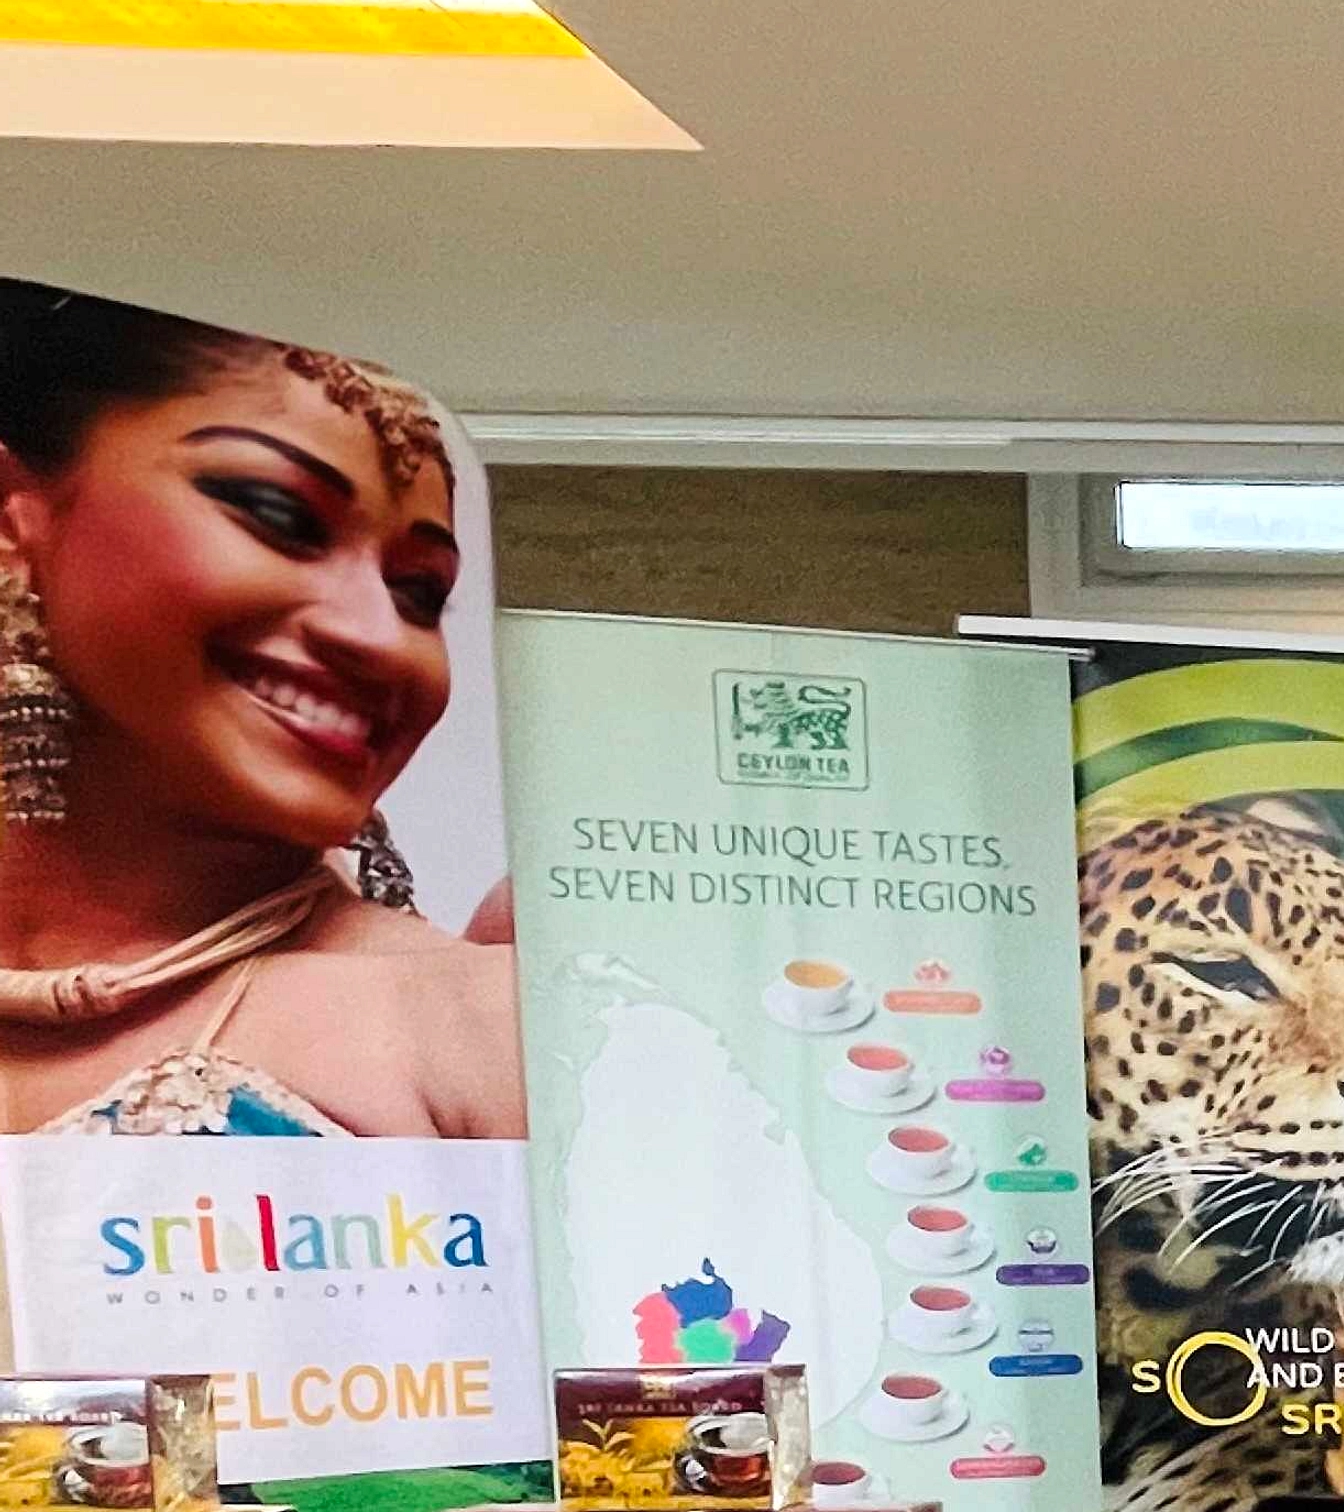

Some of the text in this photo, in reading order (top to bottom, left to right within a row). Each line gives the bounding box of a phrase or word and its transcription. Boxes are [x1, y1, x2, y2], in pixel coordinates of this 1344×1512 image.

[737, 752, 850, 773] CEYLON TEA
[573, 816, 698, 855] SEVEN
[712, 823, 860, 867] UNIQUE
[548, 866, 1036, 917] SEVEN DISTINCT REGIONS
[101, 1194, 488, 1277] sri lanka
[106, 1281, 496, 1305] WONDER OF ASIA
[1245, 1327, 1335, 1354] WILD
[1246, 1361, 1323, 1389] AND
[212, 1360, 493, 1432] ELCOME
